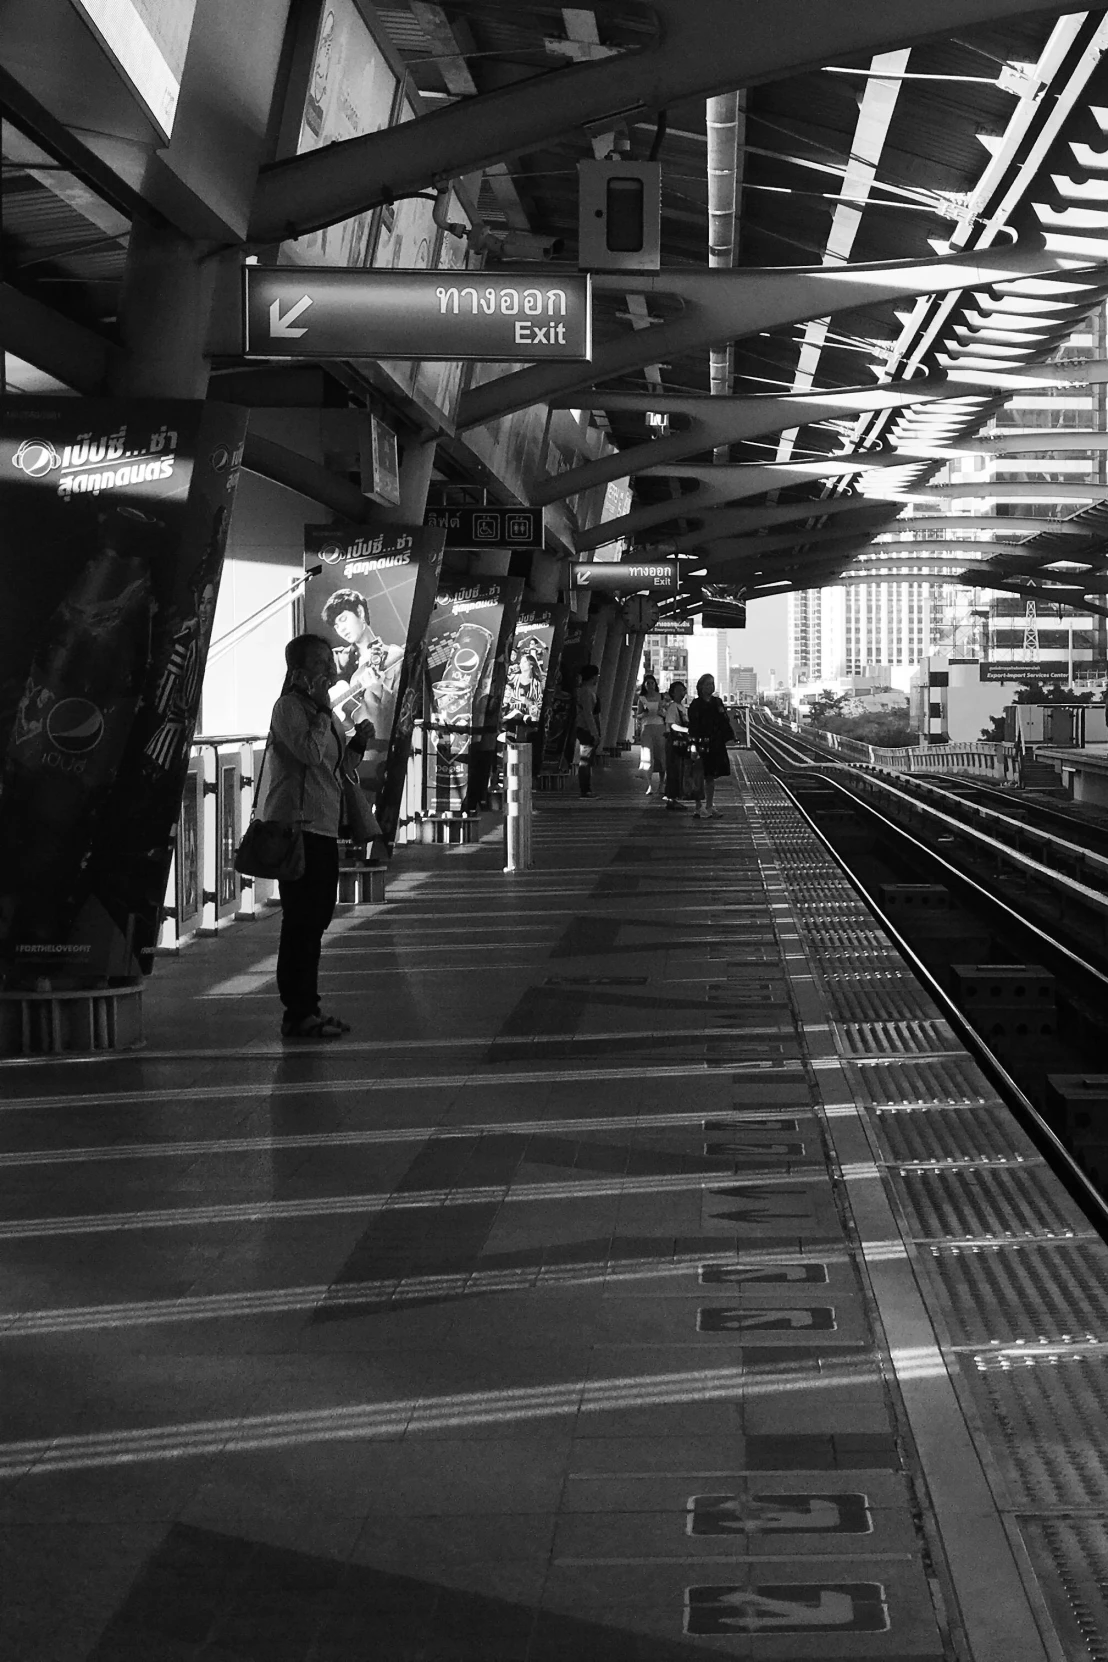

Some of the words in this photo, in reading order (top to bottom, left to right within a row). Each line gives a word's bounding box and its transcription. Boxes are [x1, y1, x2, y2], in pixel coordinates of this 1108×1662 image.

[435, 286, 566, 316] ทางออก
[514, 321, 566, 344] Exit
[57, 453, 175, 503] สุดทุกดนตรี
[428, 511, 461, 528] ลิฟต์
[343, 549, 411, 579] สุดทุกดนตรี
[629, 567, 671, 577] ทางออก
[654, 578, 671, 586] Exit
